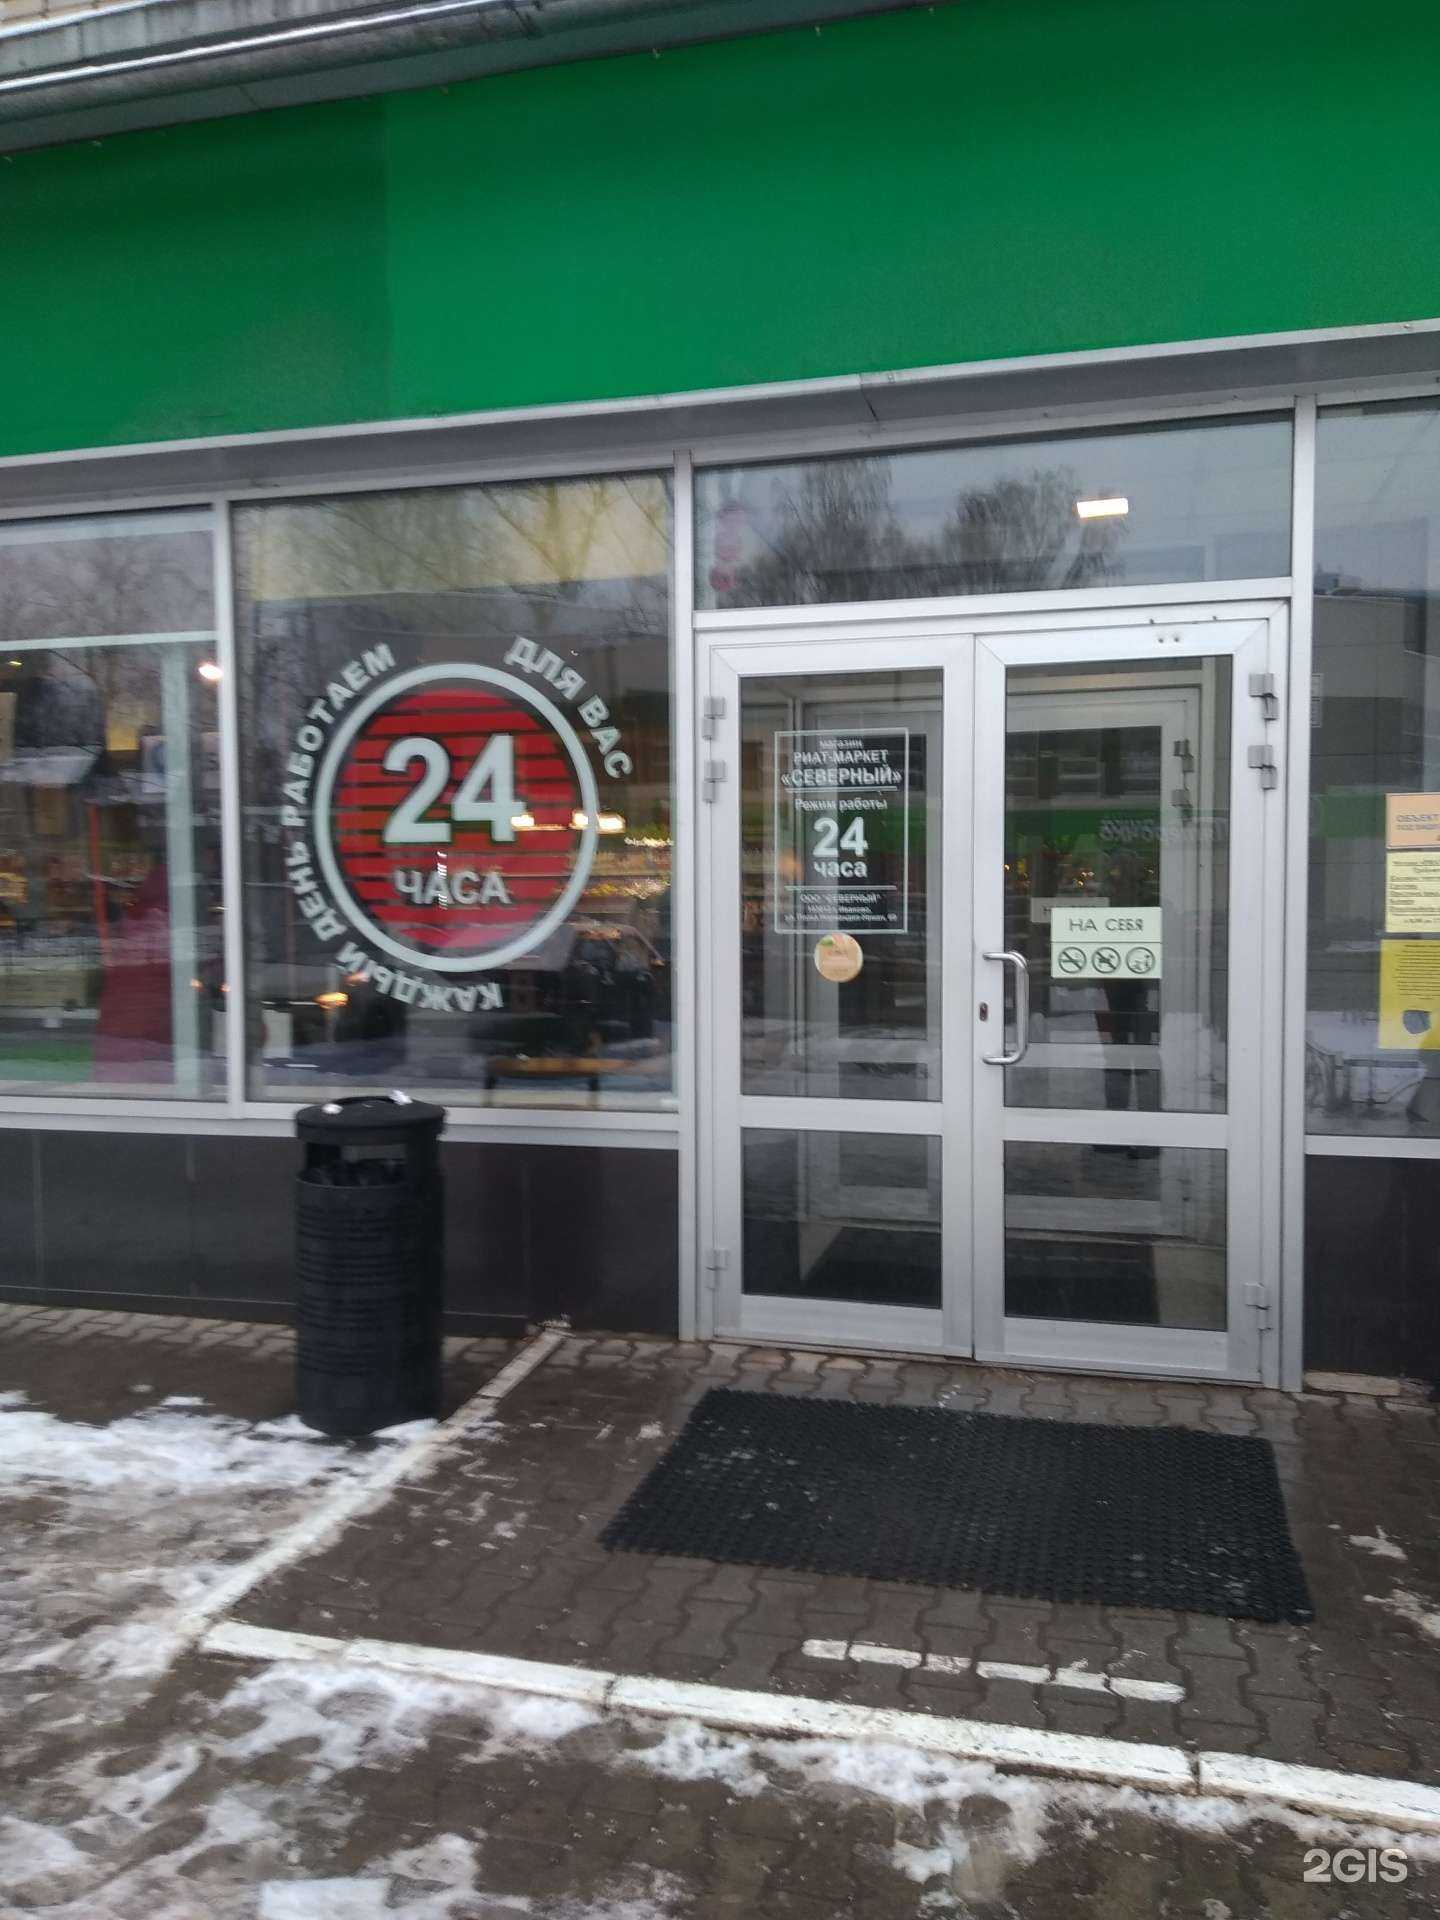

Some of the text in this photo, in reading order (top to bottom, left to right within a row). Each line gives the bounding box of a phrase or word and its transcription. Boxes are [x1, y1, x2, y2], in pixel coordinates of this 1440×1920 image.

[793, 749, 889, 765] РИАТ-МАРКЕТ
[781, 764, 902, 786] «СЕВЕРНЫЙ»
[382, 733, 527, 843] 24
[795, 797, 888, 812] Режим работы
[280, 636, 634, 1012] КАЖДЫЙ ДЕНЬ РАБОТАЕМ ДЛЯ ВАС
[813, 816, 868, 857] 24
[814, 861, 868, 878] часа
[394, 870, 511, 905] ЧАСА
[1068, 918, 1144, 932] НА СЕБЯ
